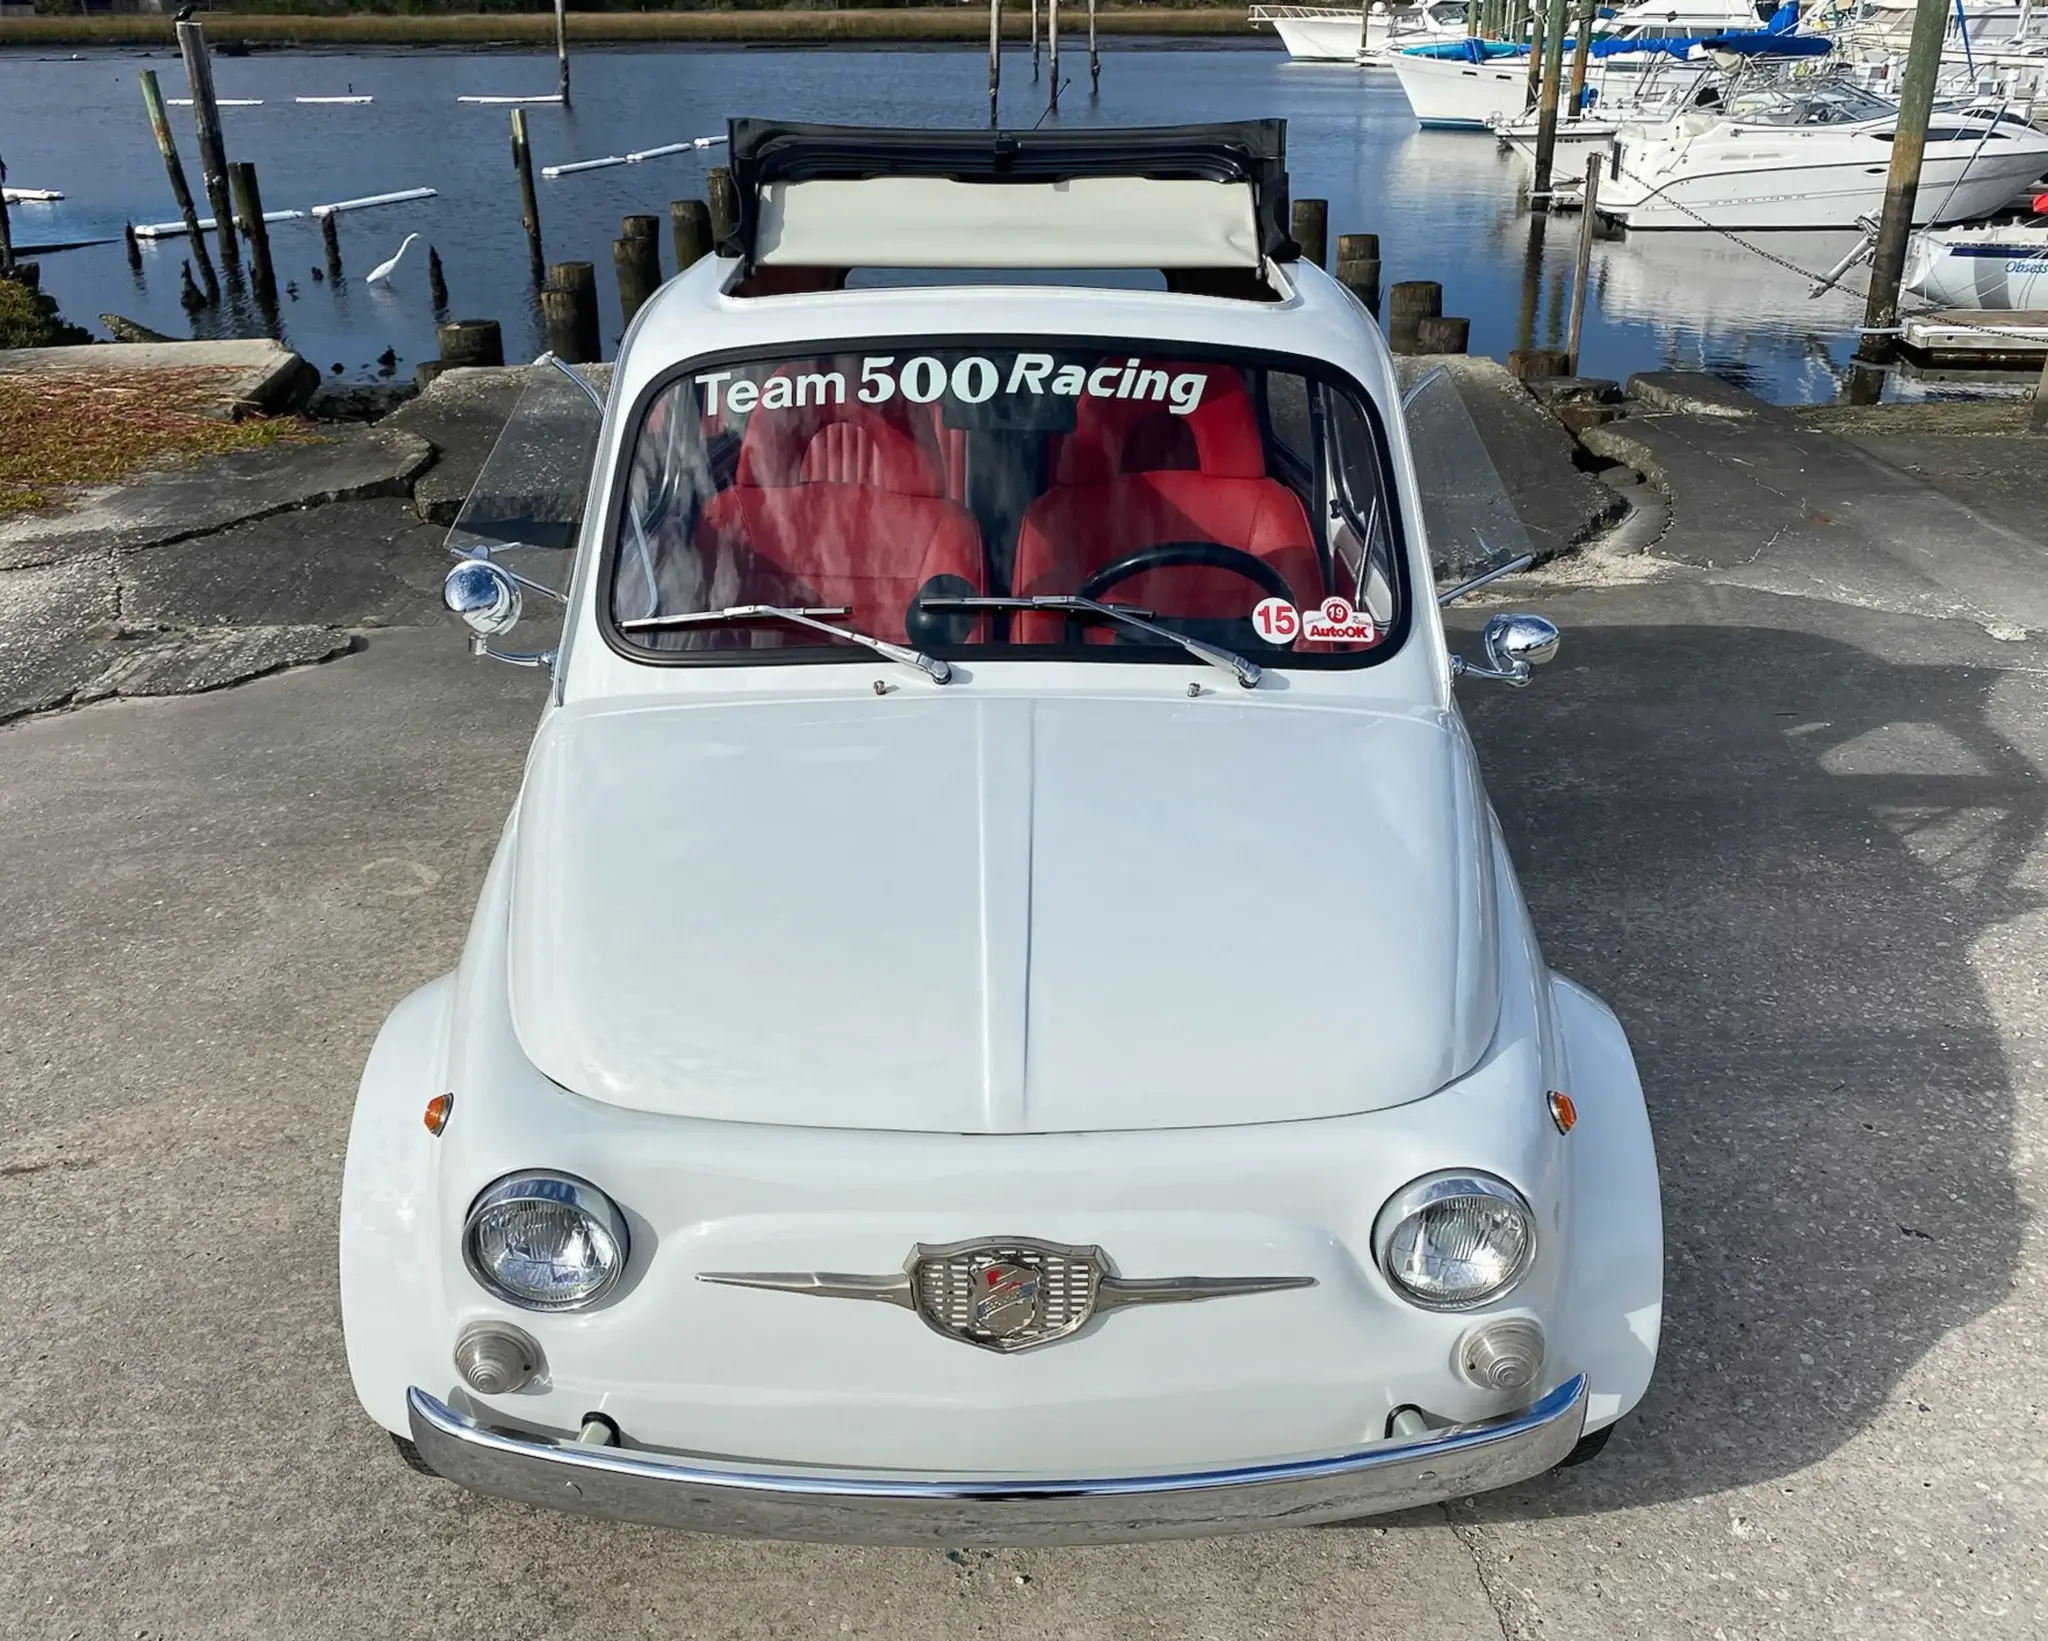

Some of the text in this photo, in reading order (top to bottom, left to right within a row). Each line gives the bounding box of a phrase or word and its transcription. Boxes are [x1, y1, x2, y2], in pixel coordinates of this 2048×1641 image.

[695, 353, 1208, 416] Team 500 Racing
[1257, 605, 1295, 635] 15
[1328, 605, 1344, 619] 19
[1310, 625, 1369, 638] AutoOK
